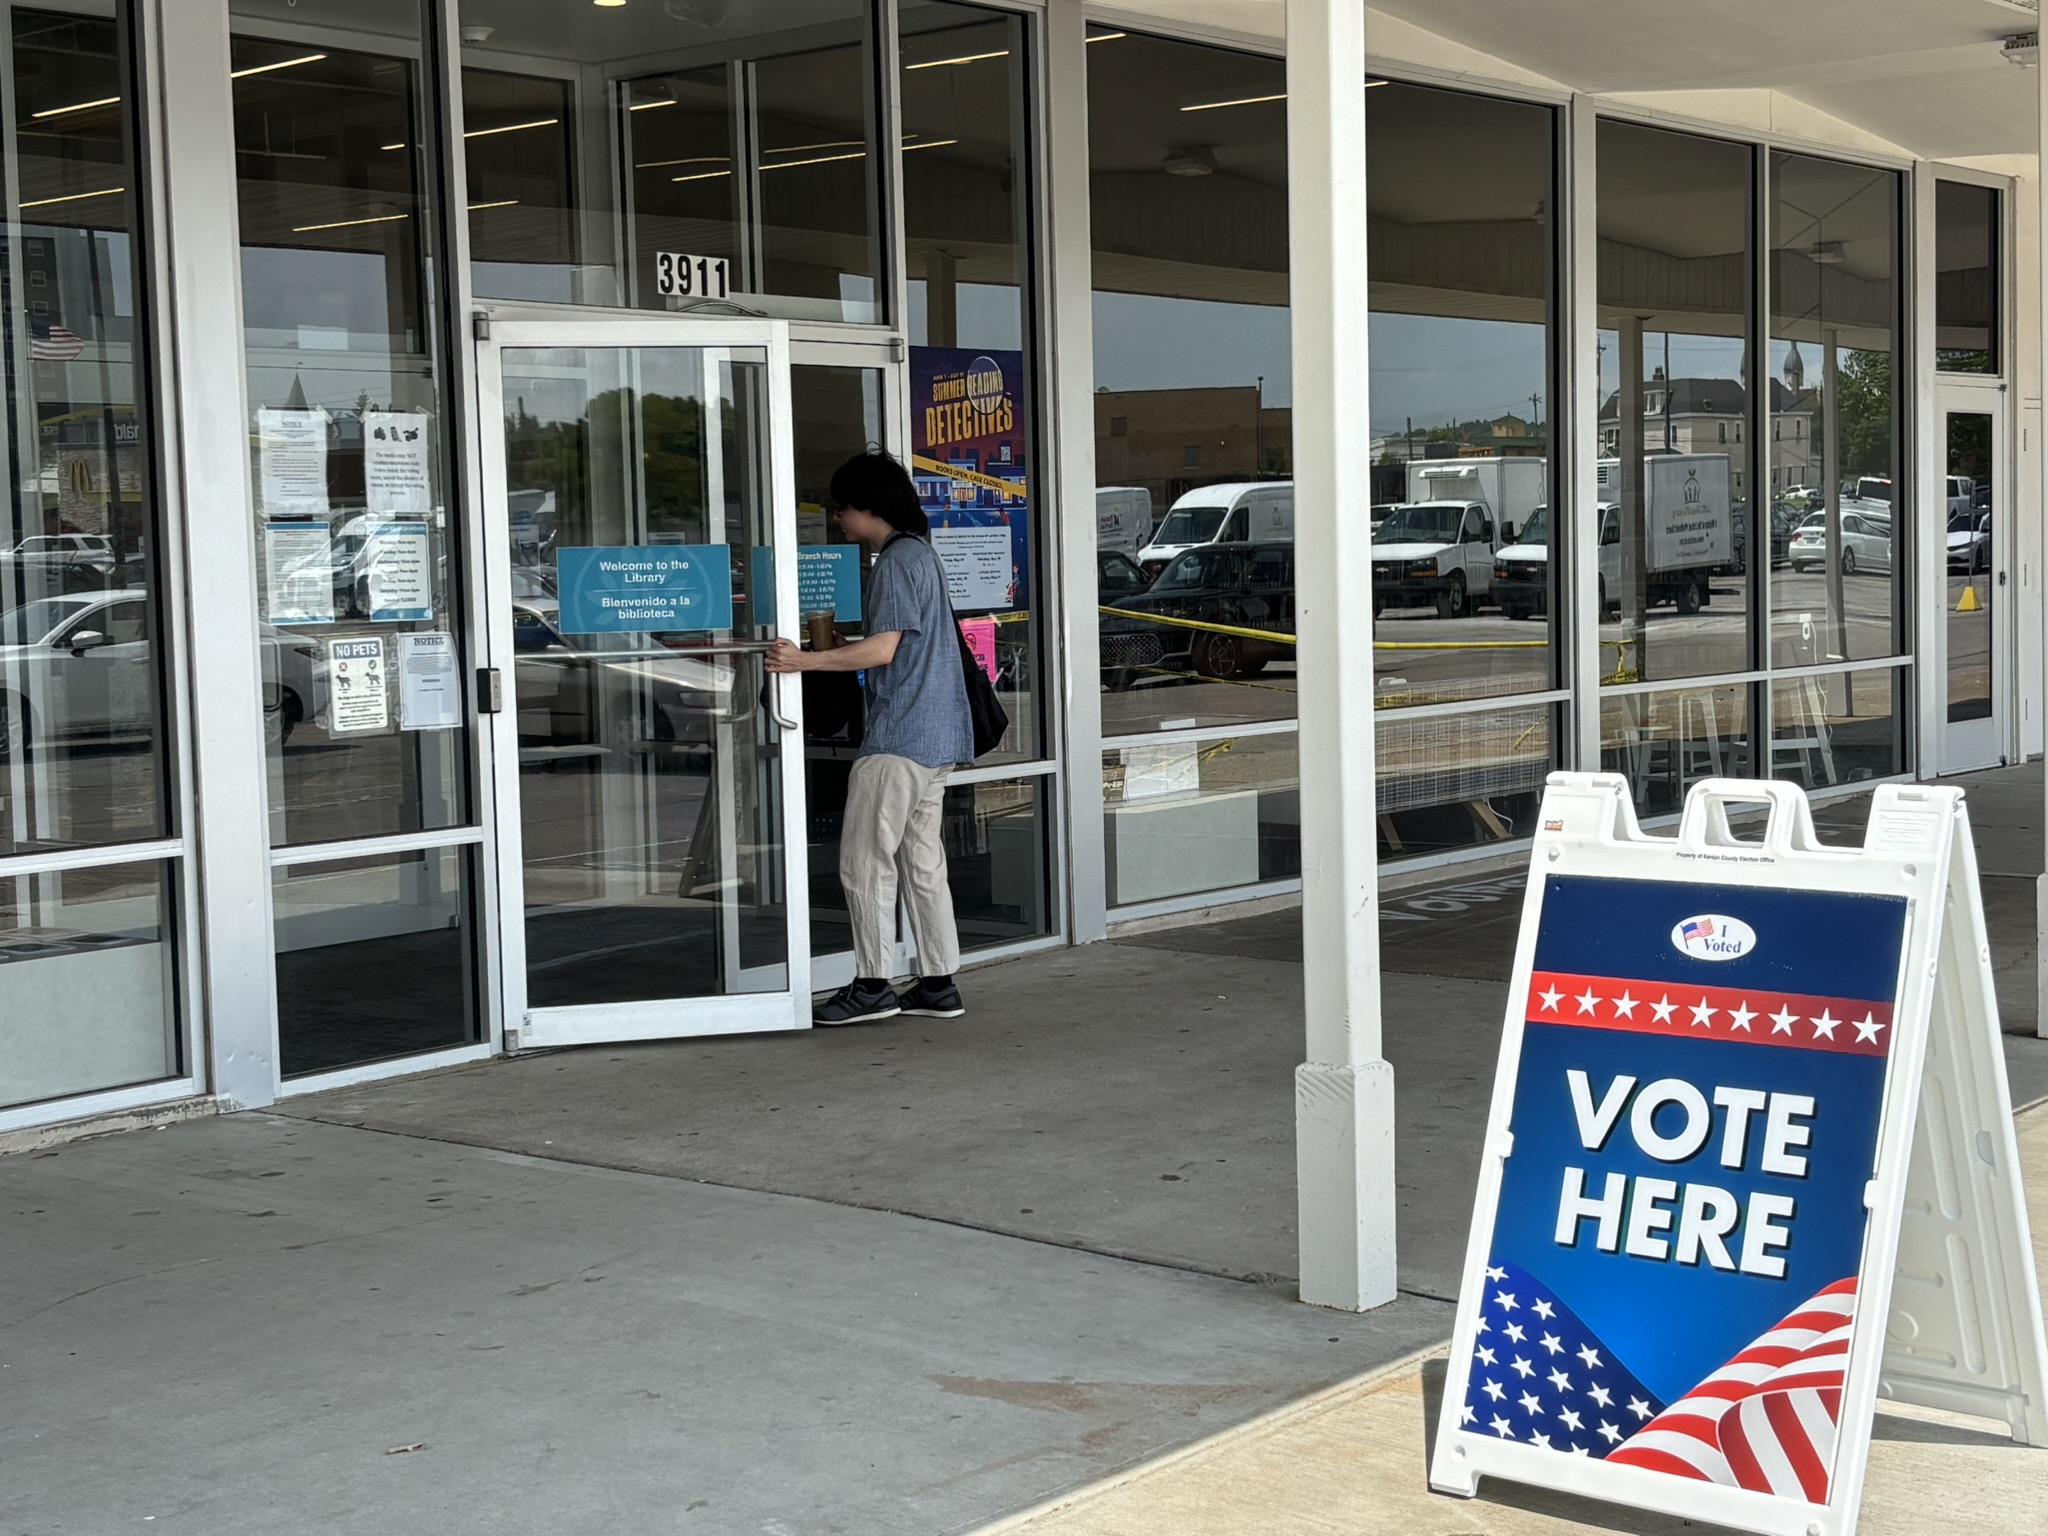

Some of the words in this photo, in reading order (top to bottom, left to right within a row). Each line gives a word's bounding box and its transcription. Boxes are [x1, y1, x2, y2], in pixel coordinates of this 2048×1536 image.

[660, 254, 726, 298] 3911
[933, 379, 966, 401] SUMMER
[967, 370, 1004, 397] READING
[926, 396, 1013, 447] DETECTIVES
[936, 465, 953, 475] BOOKS
[822, 552, 842, 560] Hours
[600, 561, 653, 571] Welcome
[656, 561, 668, 571] to
[670, 561, 689, 570] the
[624, 572, 666, 584] Library
[601, 597, 667, 608] Bienvenido
[669, 599, 677, 607] a
[679, 597, 691, 607] la
[618, 608, 675, 619] biblioteca
[336, 645, 350, 657] NO
[353, 643, 378, 656] PETS
[1676, 852, 1696, 860] Property
[1721, 855, 1738, 863] County
[1720, 924, 1727, 938] I
[1703, 938, 1741, 954] Voted
[1566, 1069, 1815, 1176] VOTE
[1554, 1166, 1795, 1278] HERE
